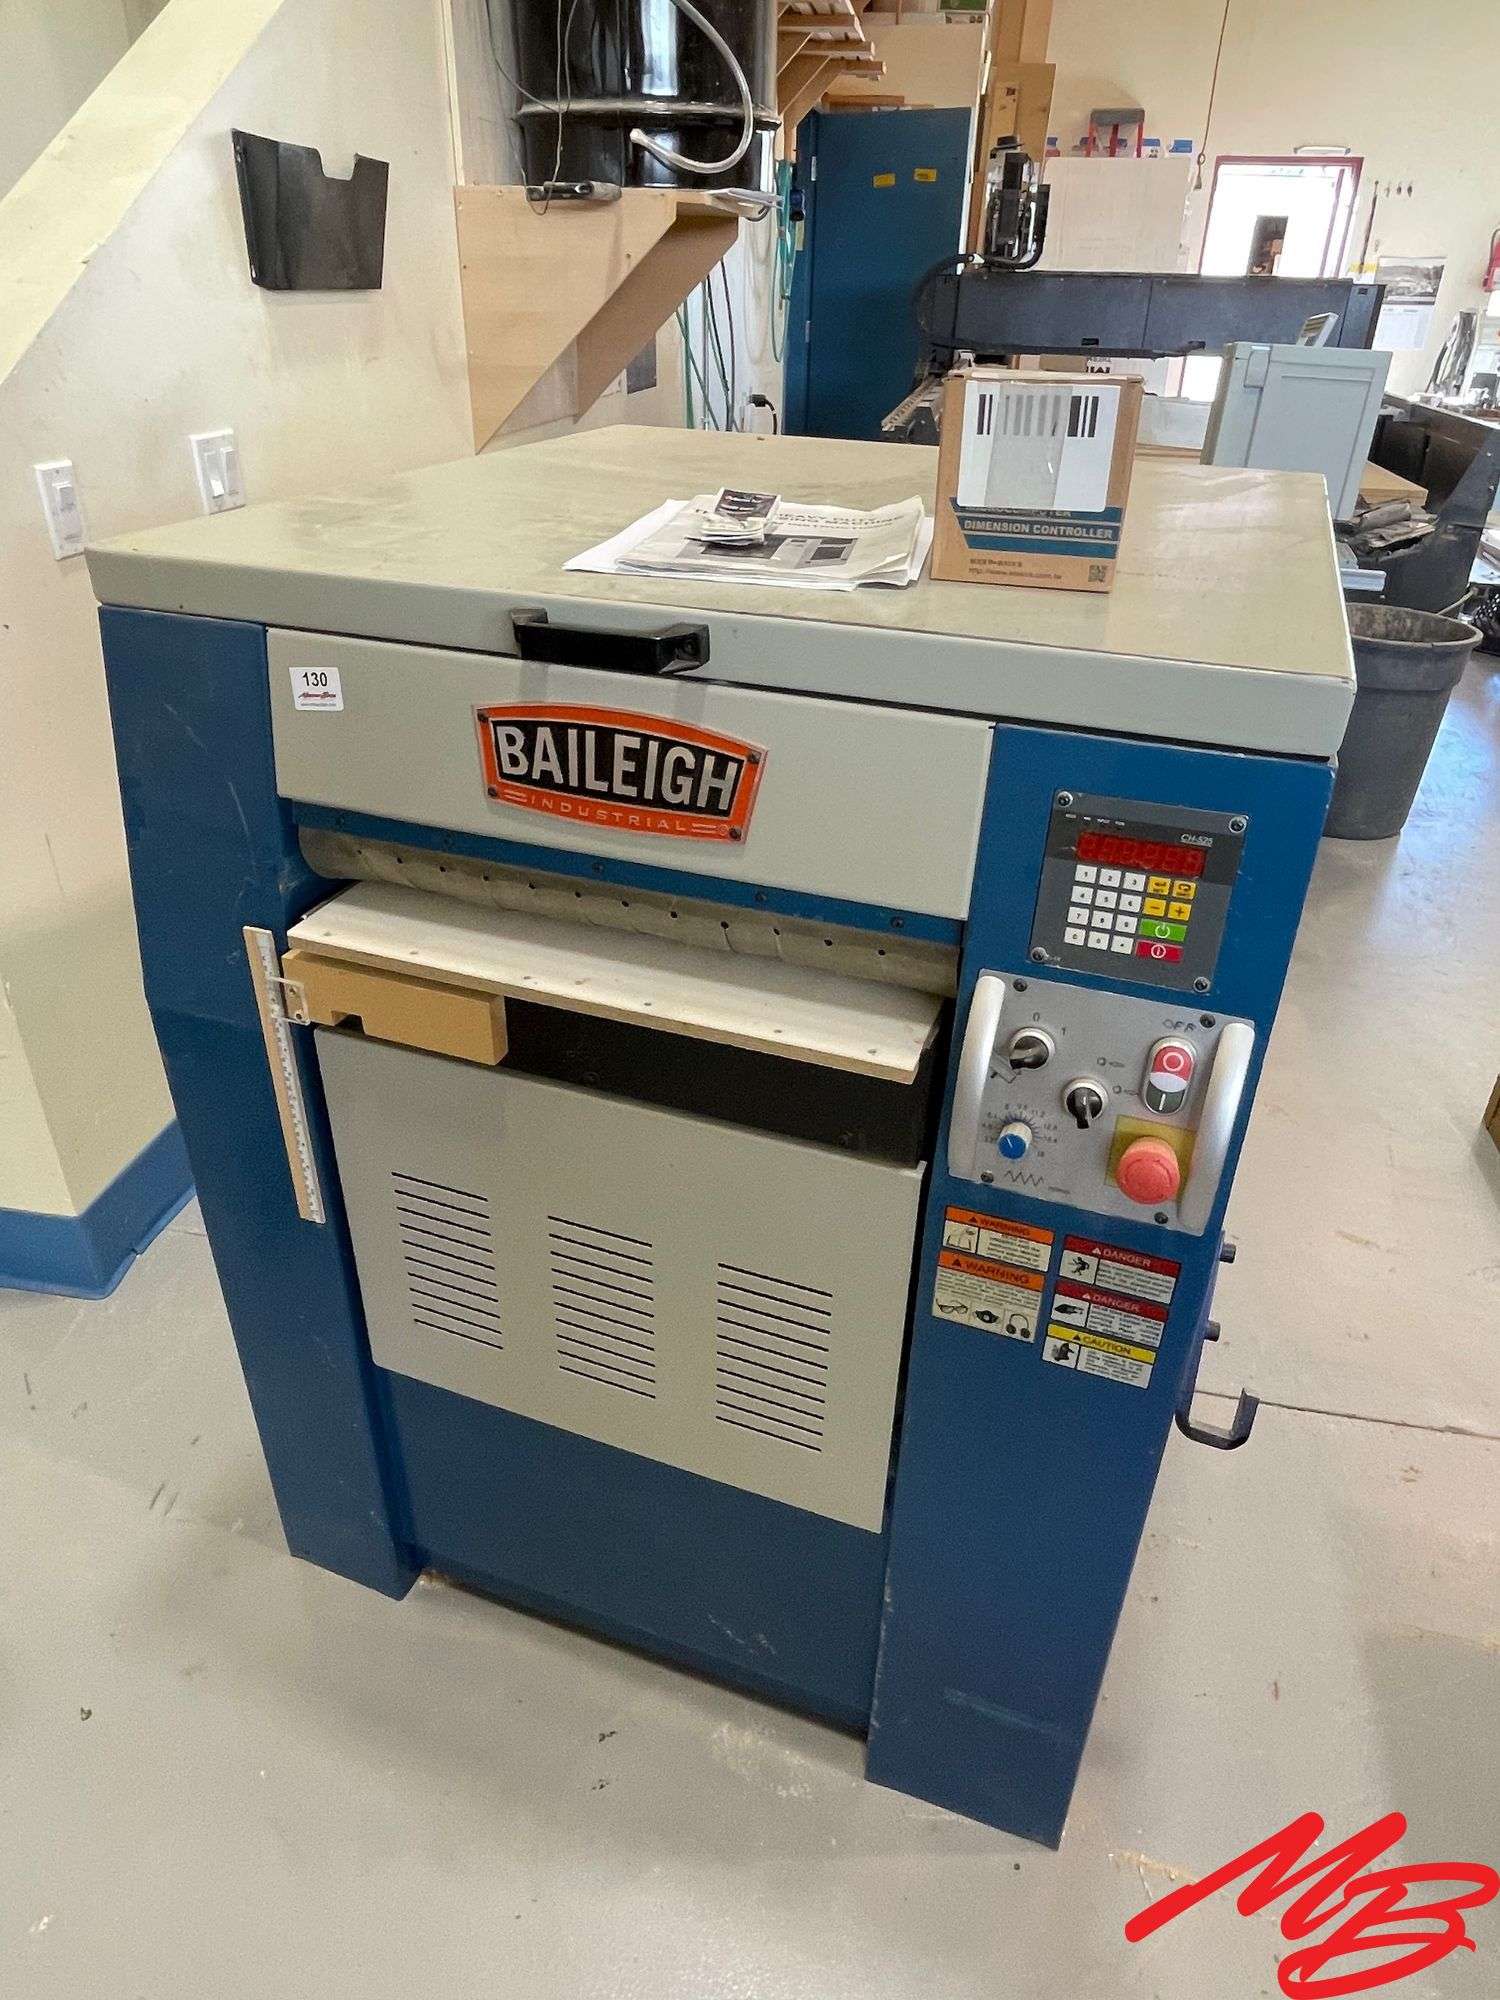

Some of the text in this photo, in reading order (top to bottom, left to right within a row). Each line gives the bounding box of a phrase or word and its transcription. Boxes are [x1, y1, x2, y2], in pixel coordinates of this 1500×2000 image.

[964, 520, 1113, 539] DIMENSION CONTROLLER
[302, 671, 328, 687] 130
[496, 725, 738, 811] BAILEIGH
[530, 794, 687, 832] INDUSTRIAL
[981, 1218, 1031, 1236] WARNING
[1103, 1247, 1152, 1268] DANGER
[966, 1261, 1030, 1284] WARNING
[1093, 1294, 1140, 1311] DANGER
[1083, 1335, 1132, 1355] CAUTION
